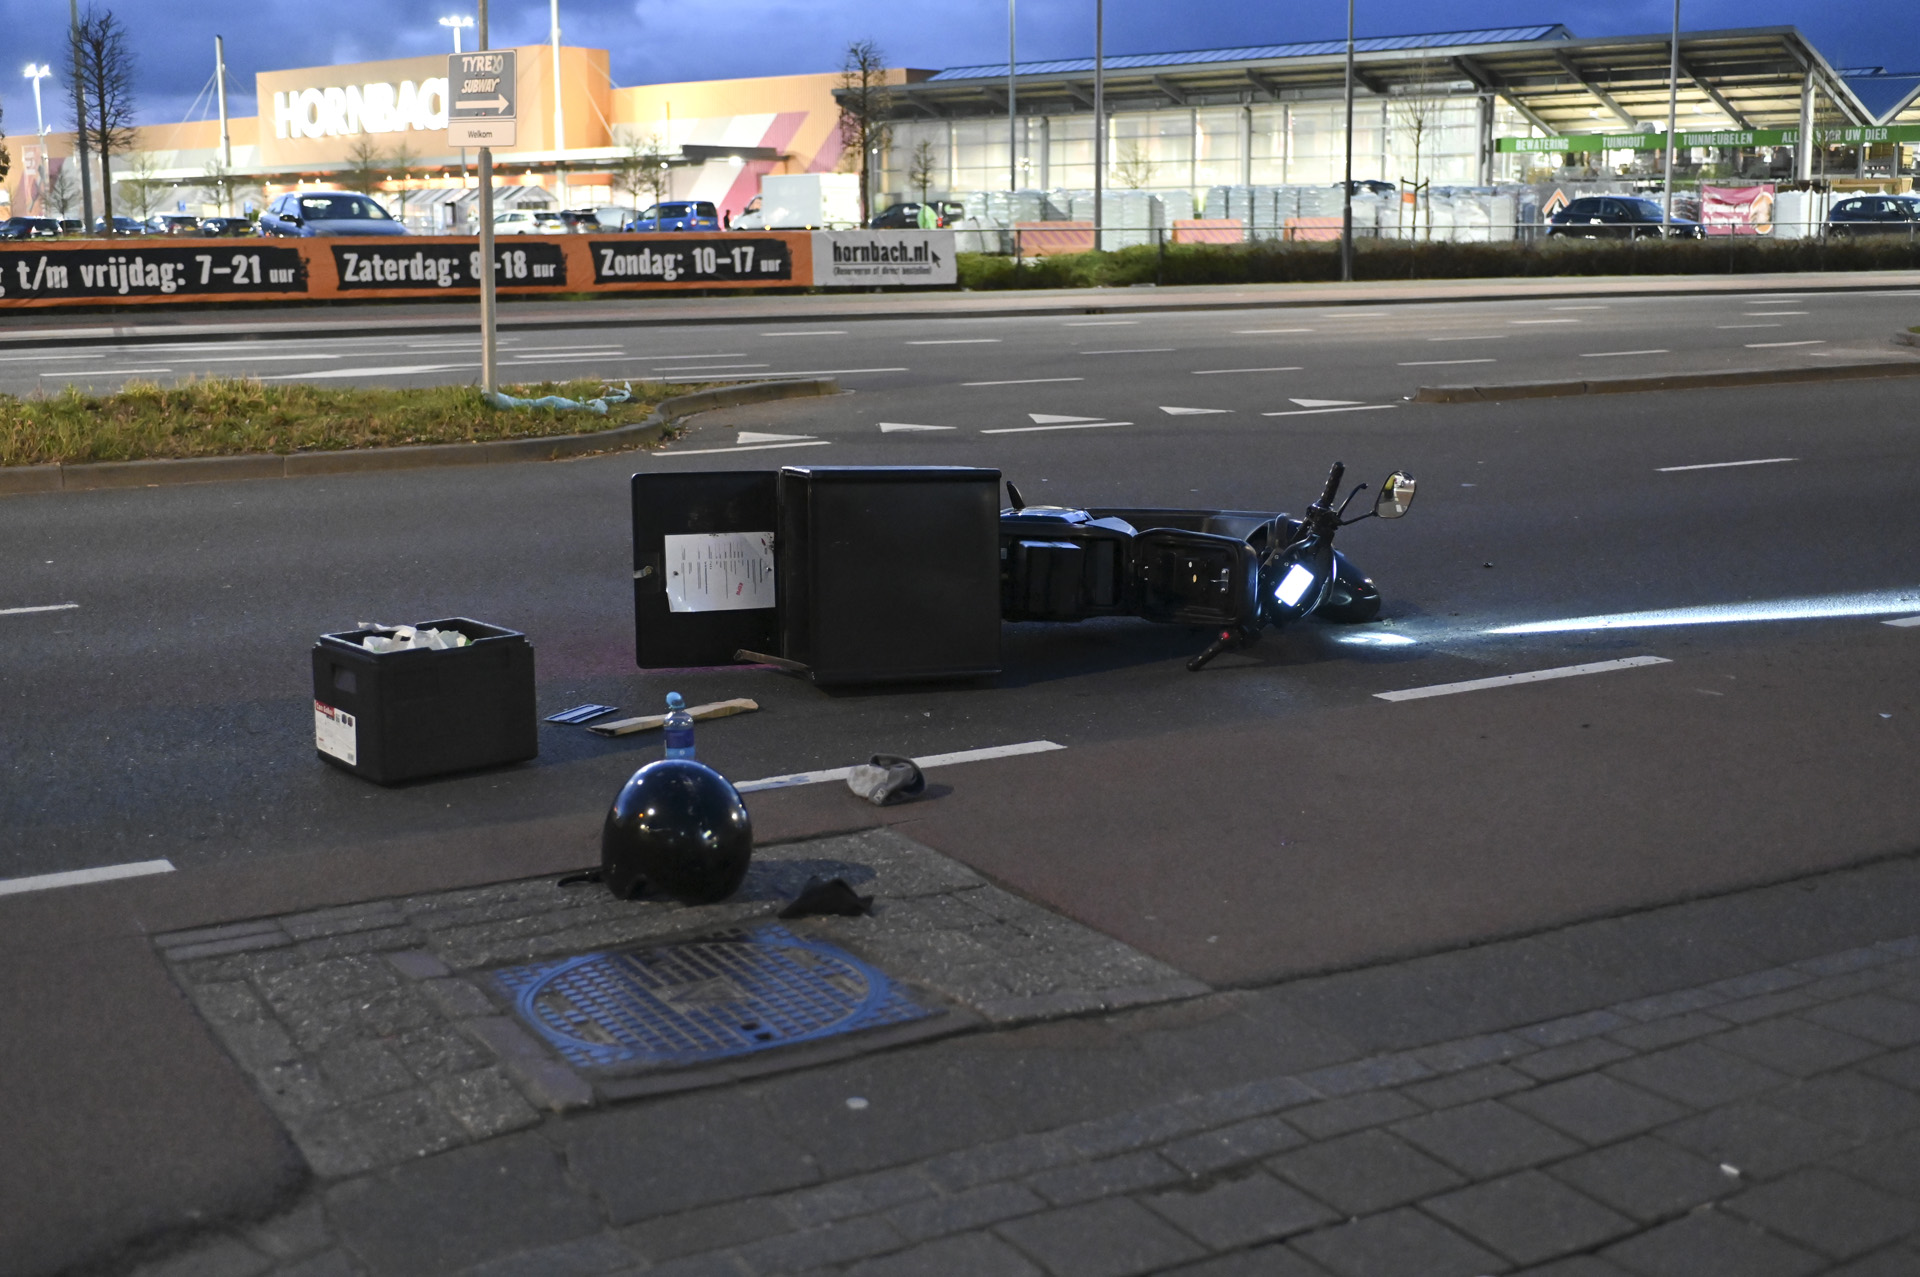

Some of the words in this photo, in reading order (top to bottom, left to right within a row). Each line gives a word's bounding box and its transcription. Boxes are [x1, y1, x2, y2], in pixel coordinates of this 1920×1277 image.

[462, 55, 504, 74] TYREX
[461, 78, 500, 93] SUBWAY
[273, 77, 449, 139] HORNBAC
[467, 130, 493, 139] Welkom
[1603, 136, 1646, 148] TUINHOUT
[1683, 132, 1753, 146] TUINMEUBELEN
[1782, 132, 1800, 144] ALL
[1845, 129, 1861, 141] UW
[1865, 128, 1888, 140] DIER
[1515, 138, 1569, 151] BEWATERING
[832, 240, 929, 262] hornbach.nl
[343, 251, 461, 287] Zaterdag:
[533, 263, 556, 278] uur
[600, 248, 684, 281] Zondag:
[692, 246, 755, 274] 10-17
[760, 259, 782, 272] uur
[17, 256, 68, 290] t/m
[80, 256, 186, 294] vrijdag:
[195, 254, 262, 284] 7-21
[269, 268, 296, 283] uur
